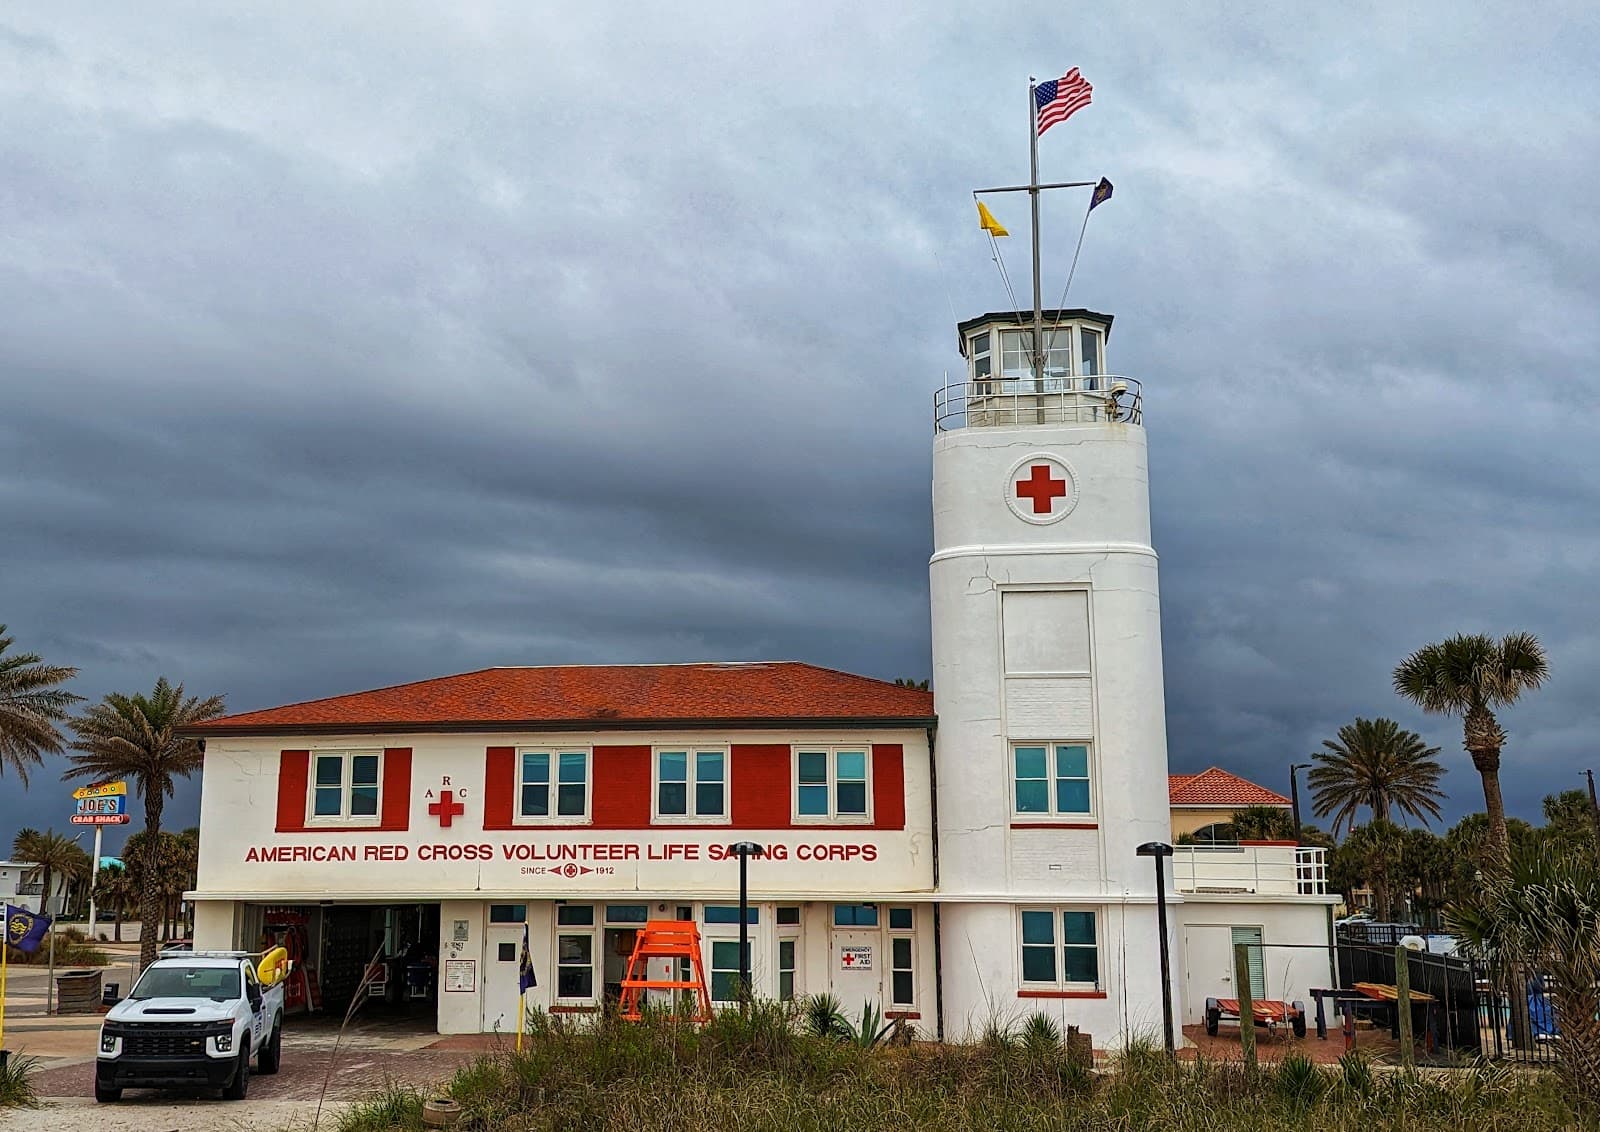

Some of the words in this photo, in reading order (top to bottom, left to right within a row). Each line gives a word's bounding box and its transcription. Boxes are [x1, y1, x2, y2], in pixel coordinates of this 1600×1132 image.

[425, 789, 433, 798] A
[442, 776, 451, 785] R
[459, 789, 467, 798] C
[79, 800, 117, 812] JOE'S
[73, 815, 94, 823] CRAB
[95, 815, 121, 823] SHACK
[245, 846, 356, 862] AMERICAN
[364, 846, 408, 861] RED
[417, 845, 493, 860] CROSS
[503, 844, 639, 860] VOLUNTEER
[648, 845, 699, 860] LIFE
[708, 844, 788, 860] SANG
[797, 844, 877, 861] CORPS
[521, 867, 546, 875] SINCE
[596, 866, 614, 875] 1912
